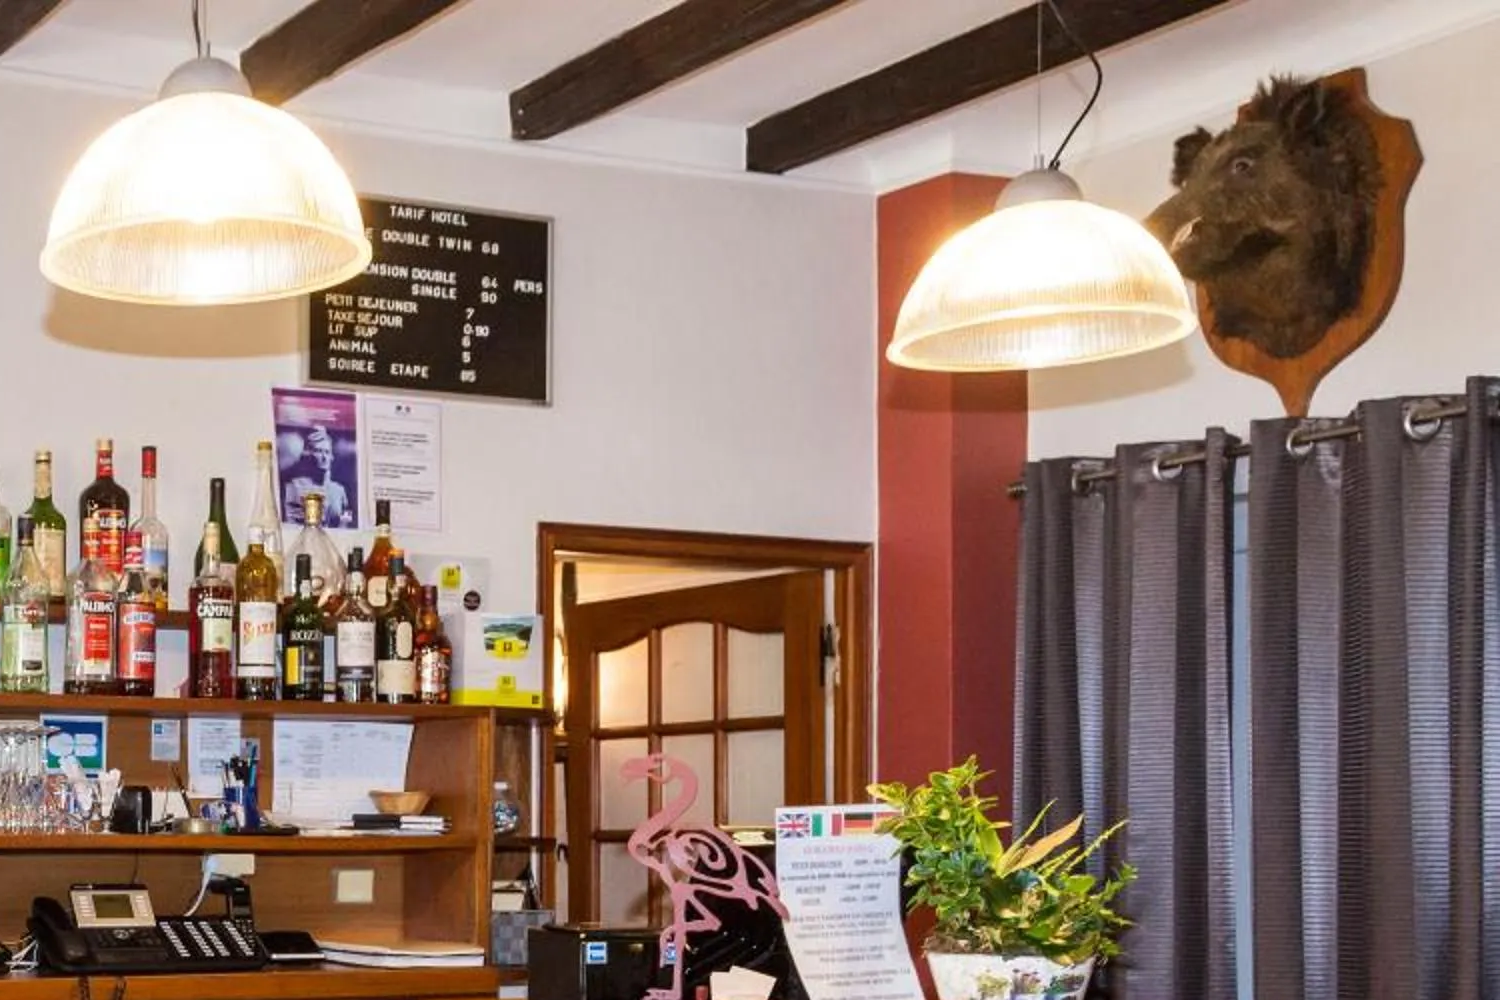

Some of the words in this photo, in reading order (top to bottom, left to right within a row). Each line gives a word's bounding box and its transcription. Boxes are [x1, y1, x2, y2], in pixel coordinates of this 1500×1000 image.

[390, 206, 424, 220] TARIF
[431, 211, 468, 227] HOTEL
[382, 229, 430, 247] DOUBLE
[439, 236, 472, 252] TWIN
[411, 266, 457, 285] DOUBLE
[514, 279, 543, 294] PERS
[411, 284, 457, 300] SINGLE
[325, 293, 353, 306] PETIT
[357, 295, 418, 314] DEJEUNER
[465, 308, 475, 320] 7
[327, 309, 354, 323] TAXE
[357, 312, 403, 328] SEJOUR
[328, 324, 344, 335] LIT
[354, 325, 378, 338] SUP
[329, 339, 376, 354] ANIMAL
[328, 357, 376, 374] SOIREE
[390, 362, 429, 379] ETAPE
